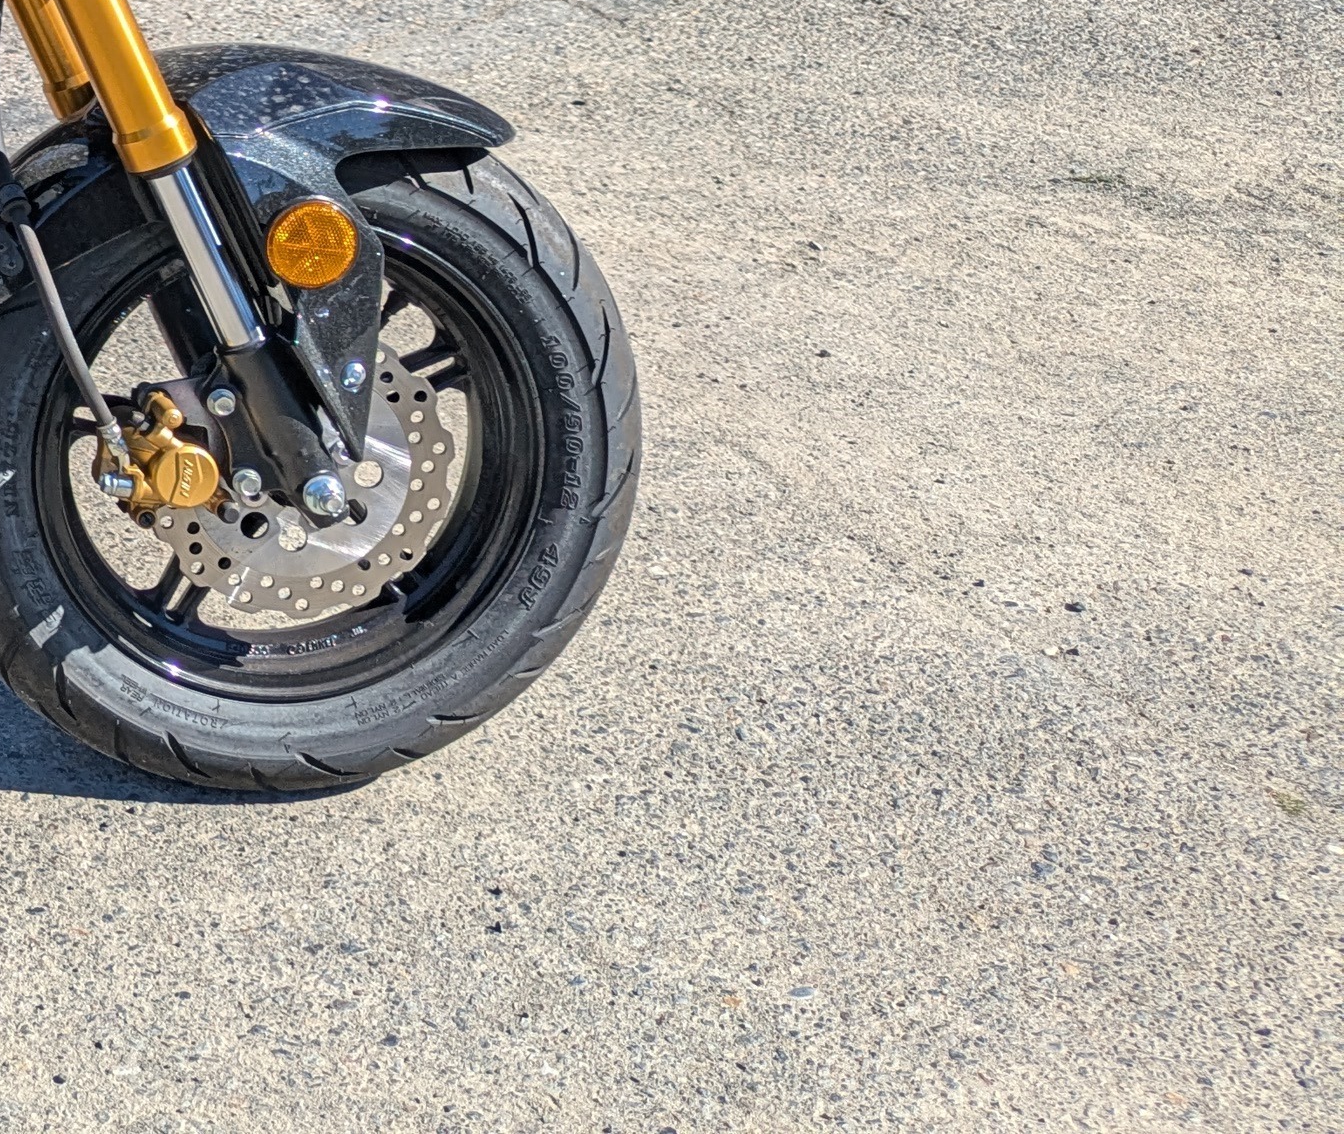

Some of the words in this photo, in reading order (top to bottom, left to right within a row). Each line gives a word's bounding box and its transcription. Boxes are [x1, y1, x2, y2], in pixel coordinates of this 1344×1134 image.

[539, 335, 584, 511] 100/90-12
[517, 543, 561, 611] 49J
[120, 684, 144, 702] REAR
[152, 698, 217, 729] ROTATION
